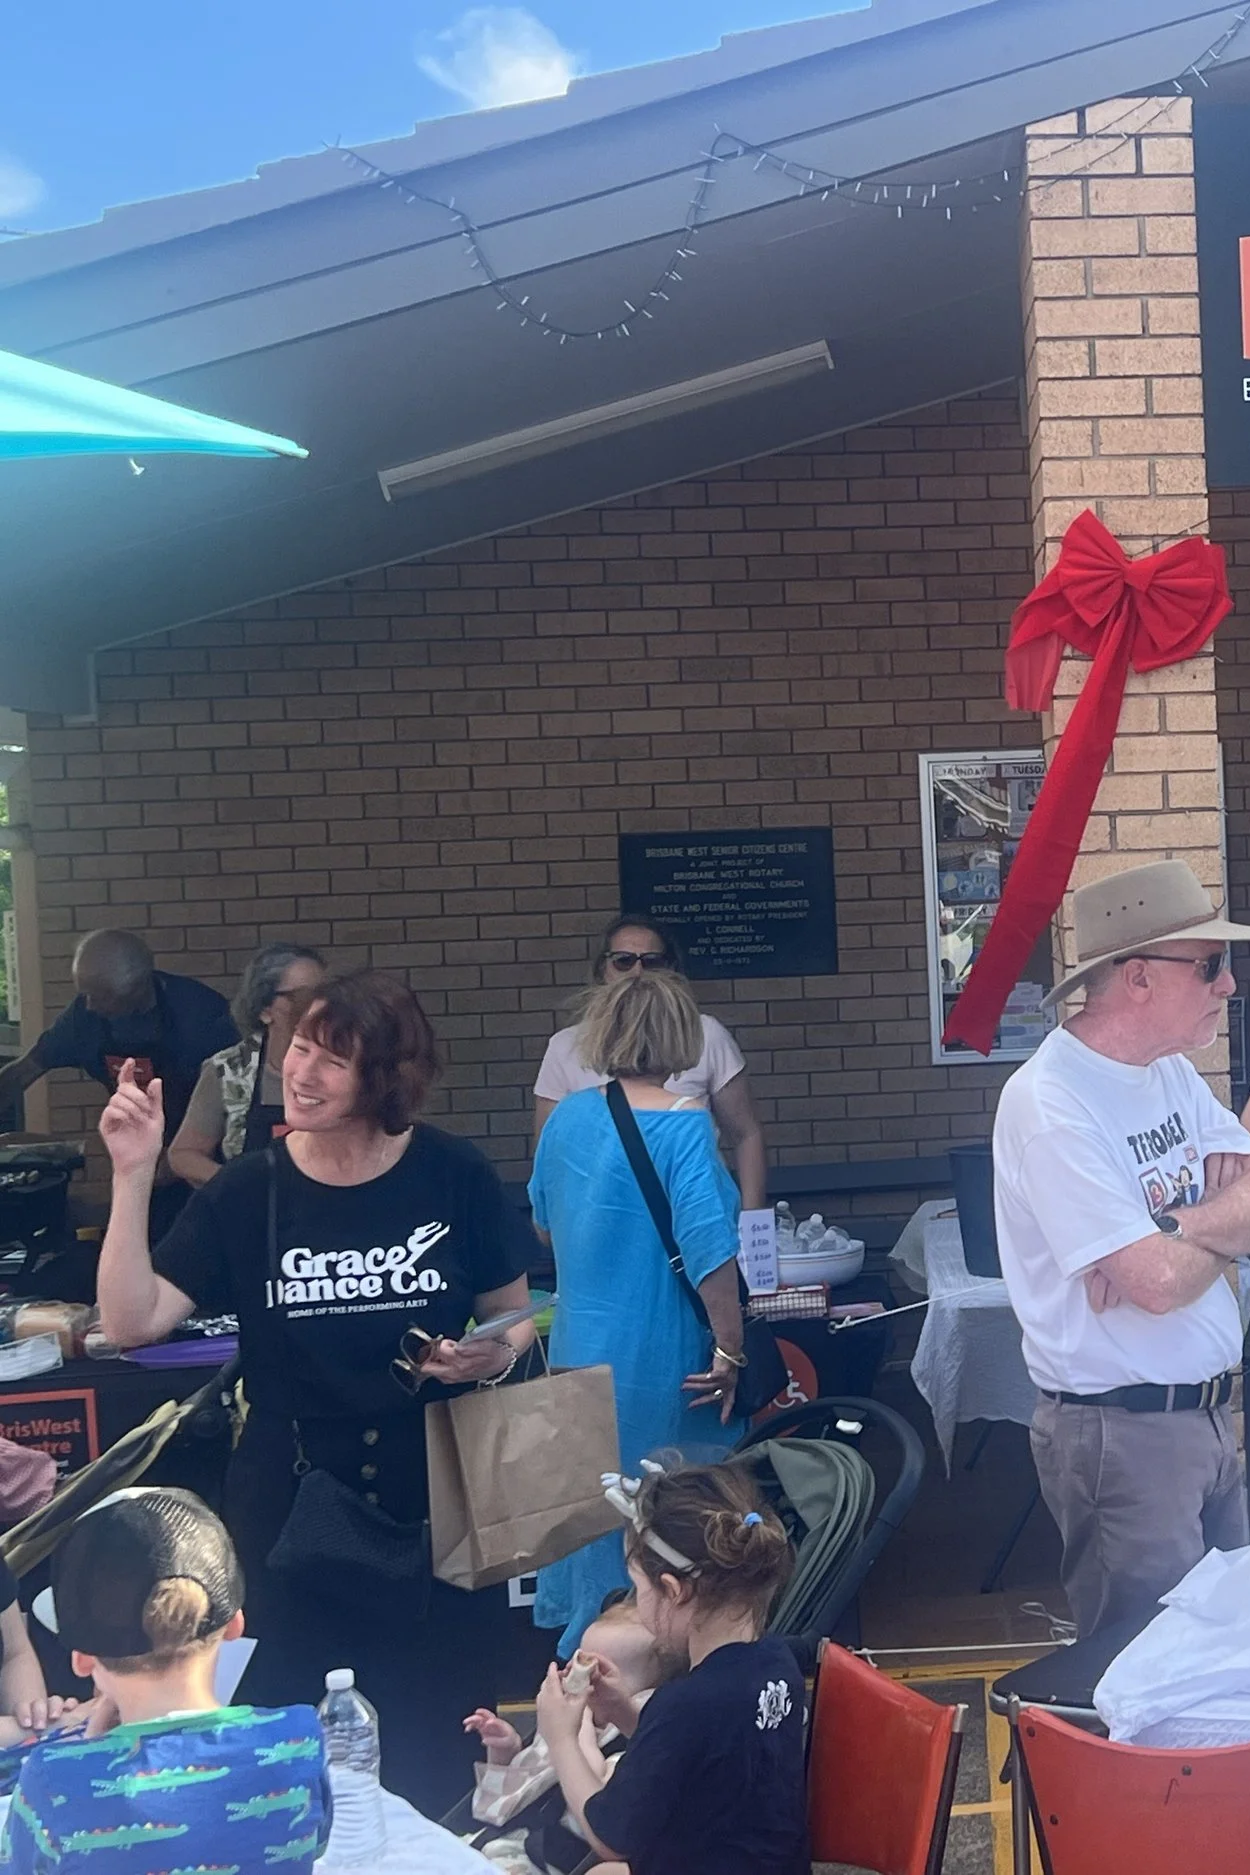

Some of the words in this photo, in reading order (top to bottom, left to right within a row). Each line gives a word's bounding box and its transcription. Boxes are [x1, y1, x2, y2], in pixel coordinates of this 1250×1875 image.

[1012, 766, 1044, 775] TUESD
[645, 847, 684, 858] BRISBANE
[687, 846, 708, 857] WEST
[711, 845, 739, 856] SENIOR
[673, 870, 716, 881] BRISBANE
[720, 869, 745, 879] WEST
[748, 867, 784, 878] ROTARY
[651, 904, 680, 914] STATE
[683, 903, 701, 913] AND
[703, 902, 742, 912] FEDERAL
[744, 899, 810, 910] GOVERNMENTS
[281, 1240, 416, 1279] Grace
[390, 1266, 448, 1295] Co.
[287, 1308, 315, 1320] HOME
[315, 1307, 328, 1316] OF
[328, 1306, 347, 1315] THE
[347, 1302, 405, 1314] PERFORMING
[405, 1299, 429, 1309] ARTS
